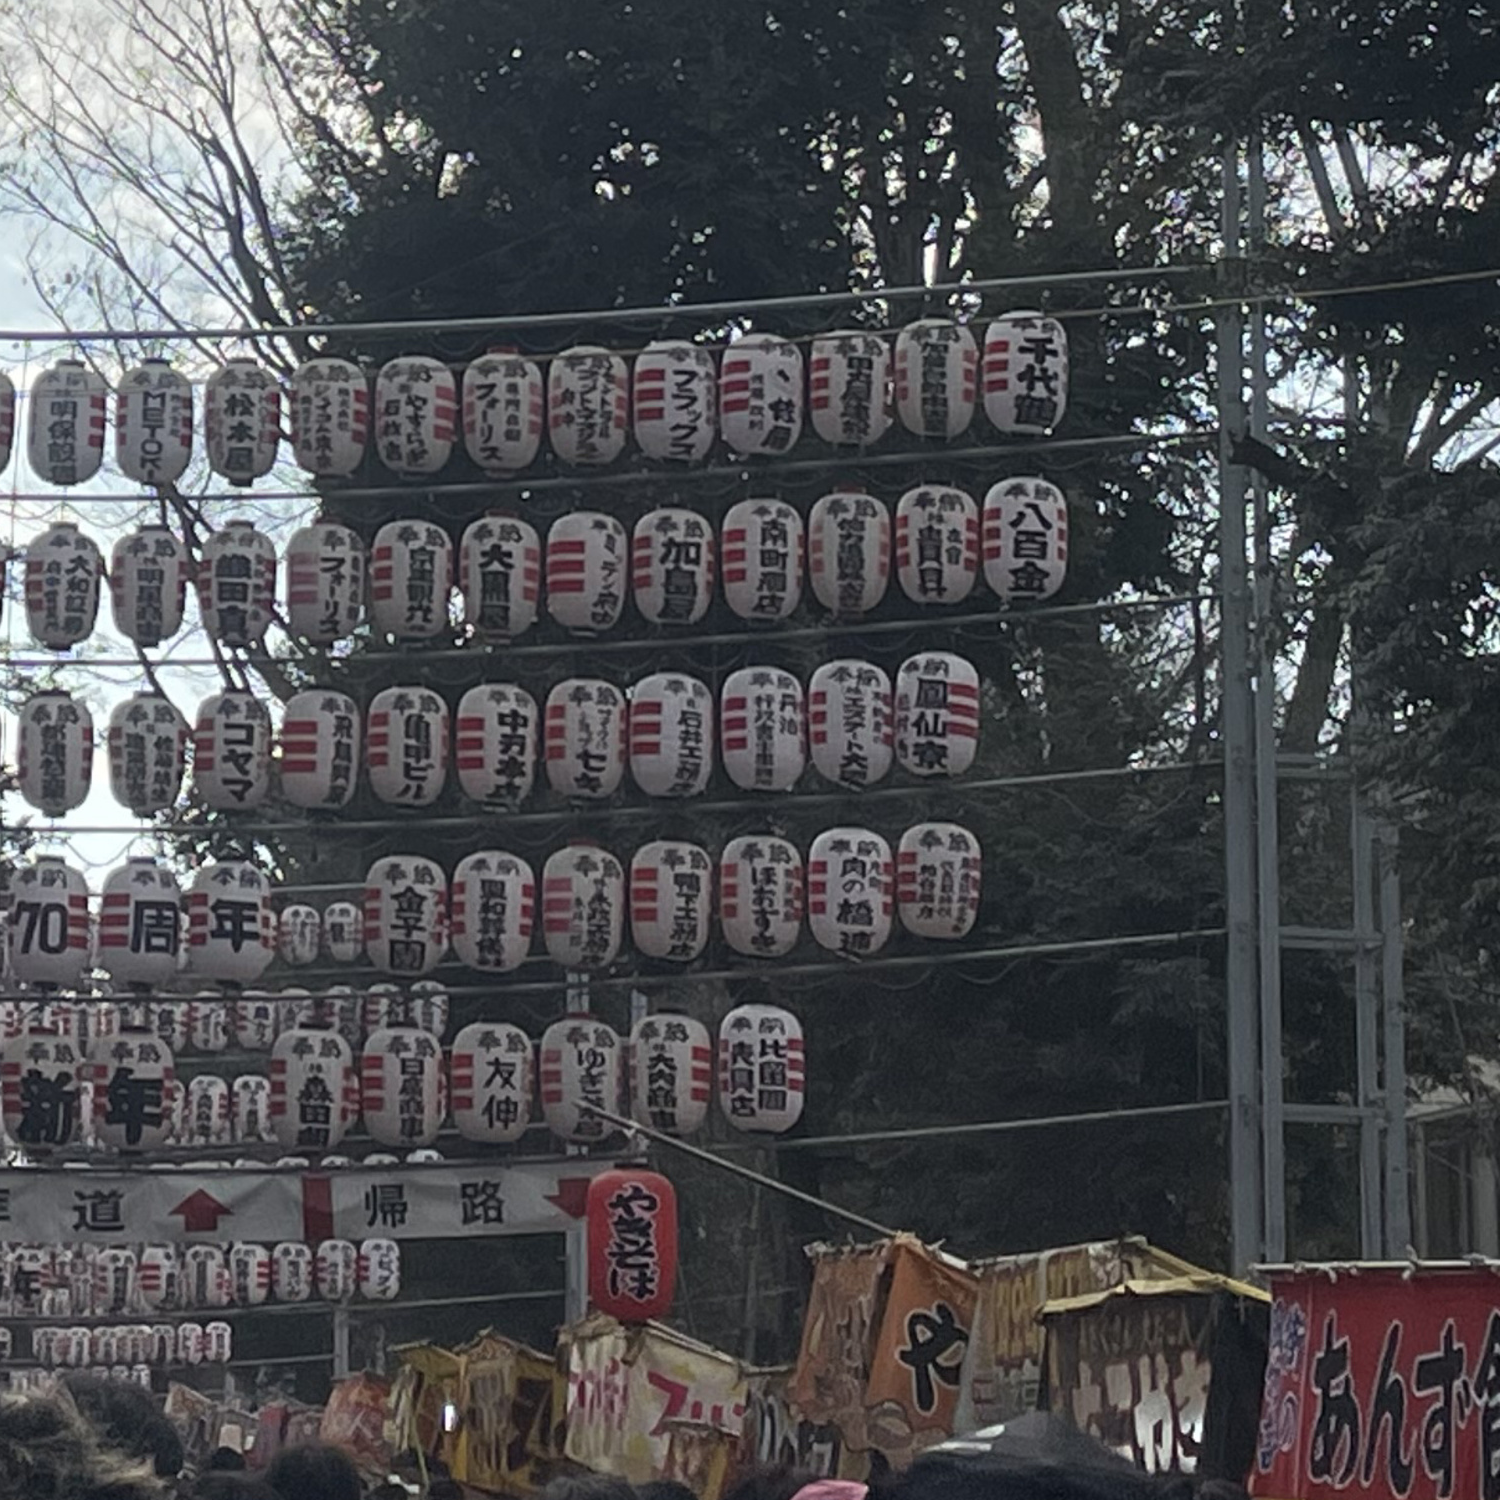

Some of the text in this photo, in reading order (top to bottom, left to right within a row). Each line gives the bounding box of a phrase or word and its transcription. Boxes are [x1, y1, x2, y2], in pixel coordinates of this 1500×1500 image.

[139, 391, 164, 482] METOKI
[475, 382, 501, 461] フォーリス
[1008, 502, 1052, 592] 八百金
[320, 555, 345, 635] フォーリス
[220, 722, 254, 802] コヤマ
[483, 1057, 519, 1130] 友伸
[364, 1180, 506, 1229] 帰路
[607, 1184, 661, 1301] やきそば
